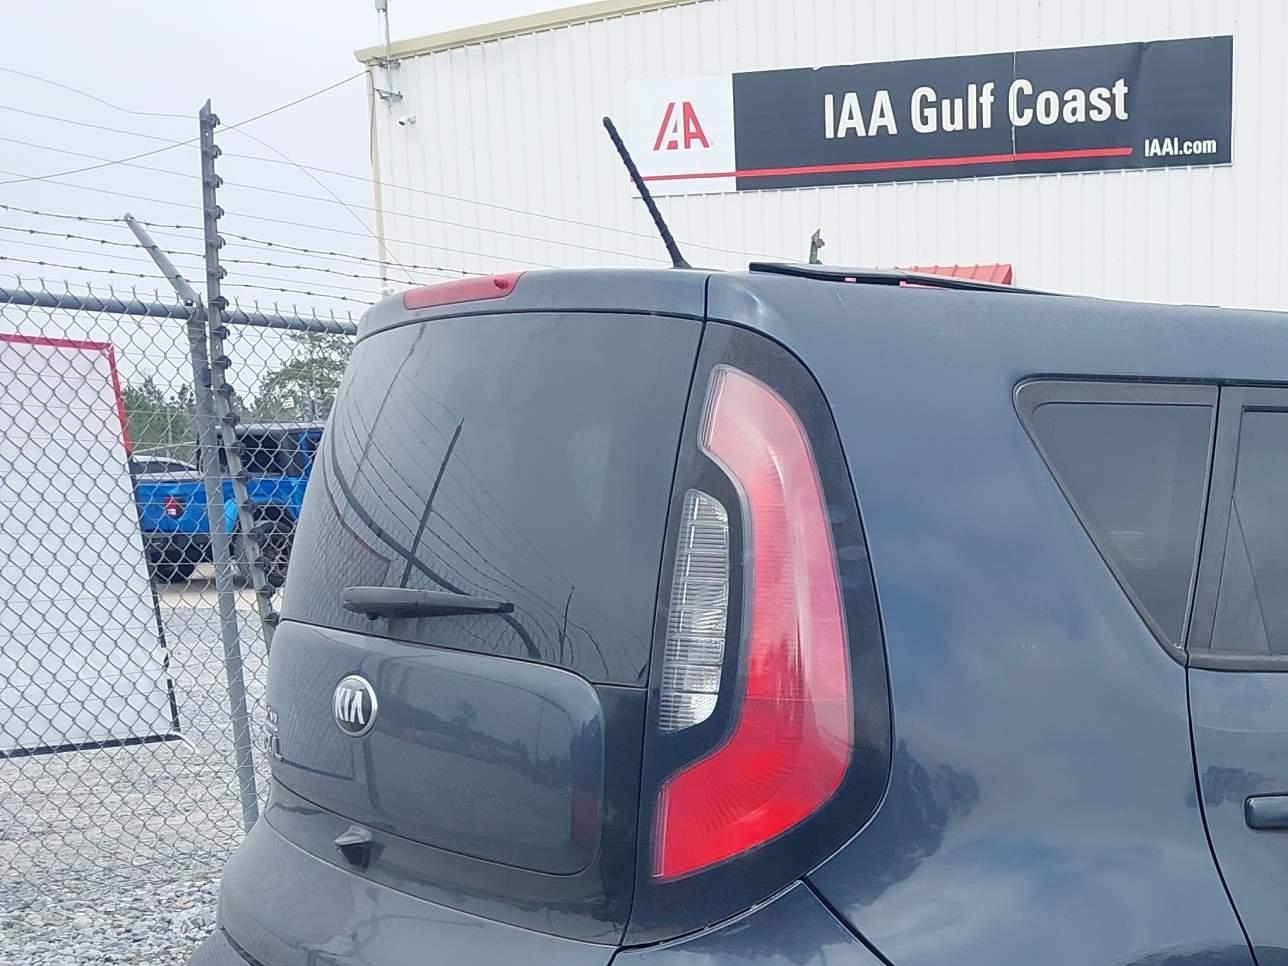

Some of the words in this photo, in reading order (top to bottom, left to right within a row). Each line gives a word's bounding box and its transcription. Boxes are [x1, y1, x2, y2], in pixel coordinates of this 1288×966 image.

[824, 90, 898, 139] IAA
[910, 82, 995, 134] Gulf
[1008, 78, 1129, 127] Coast
[1144, 136, 1217, 158] IAAI.com
[335, 686, 366, 725] KIA
